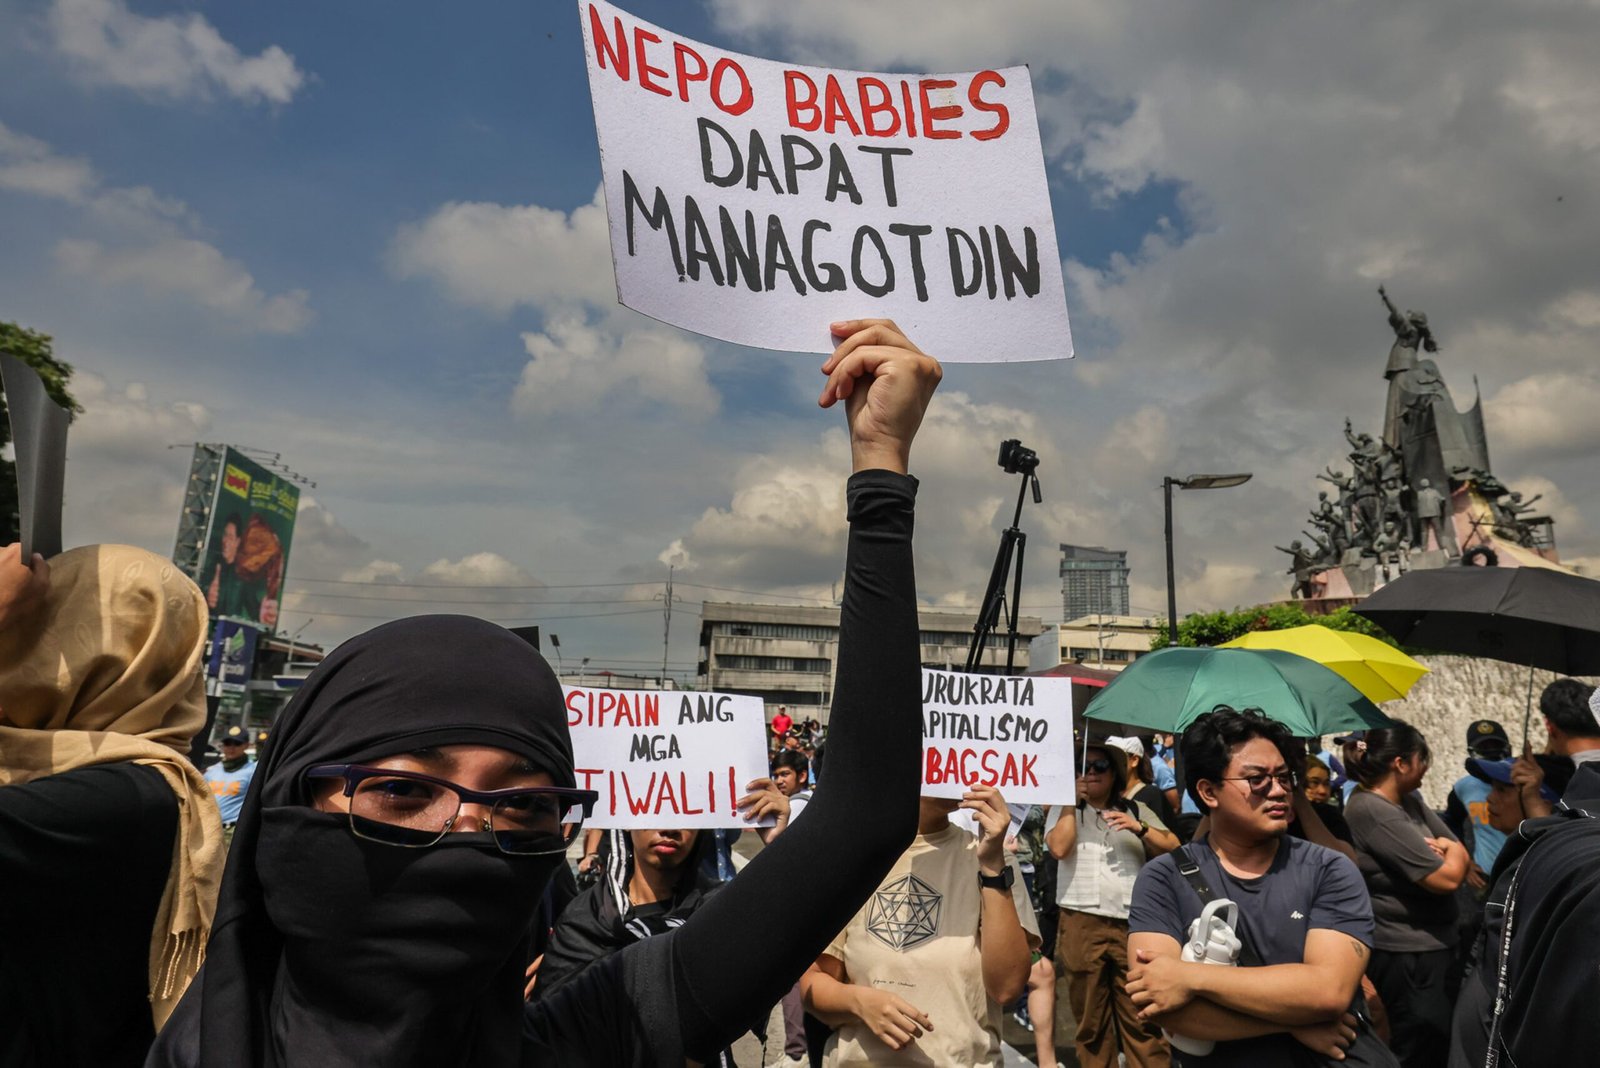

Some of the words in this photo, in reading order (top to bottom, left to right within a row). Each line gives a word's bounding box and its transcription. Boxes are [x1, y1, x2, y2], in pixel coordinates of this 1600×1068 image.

[588, 3, 755, 117] NEPO
[783, 69, 1011, 142] BABIES
[696, 116, 914, 208] DAPAT
[622, 169, 933, 303] MANAGOT
[945, 224, 1041, 302] DIN
[564, 689, 660, 728] SIPAIN
[677, 694, 735, 725] ANG
[922, 671, 1034, 706] URUKRATA
[629, 733, 682, 762] MGA
[572, 766, 739, 818] TIWALI!
